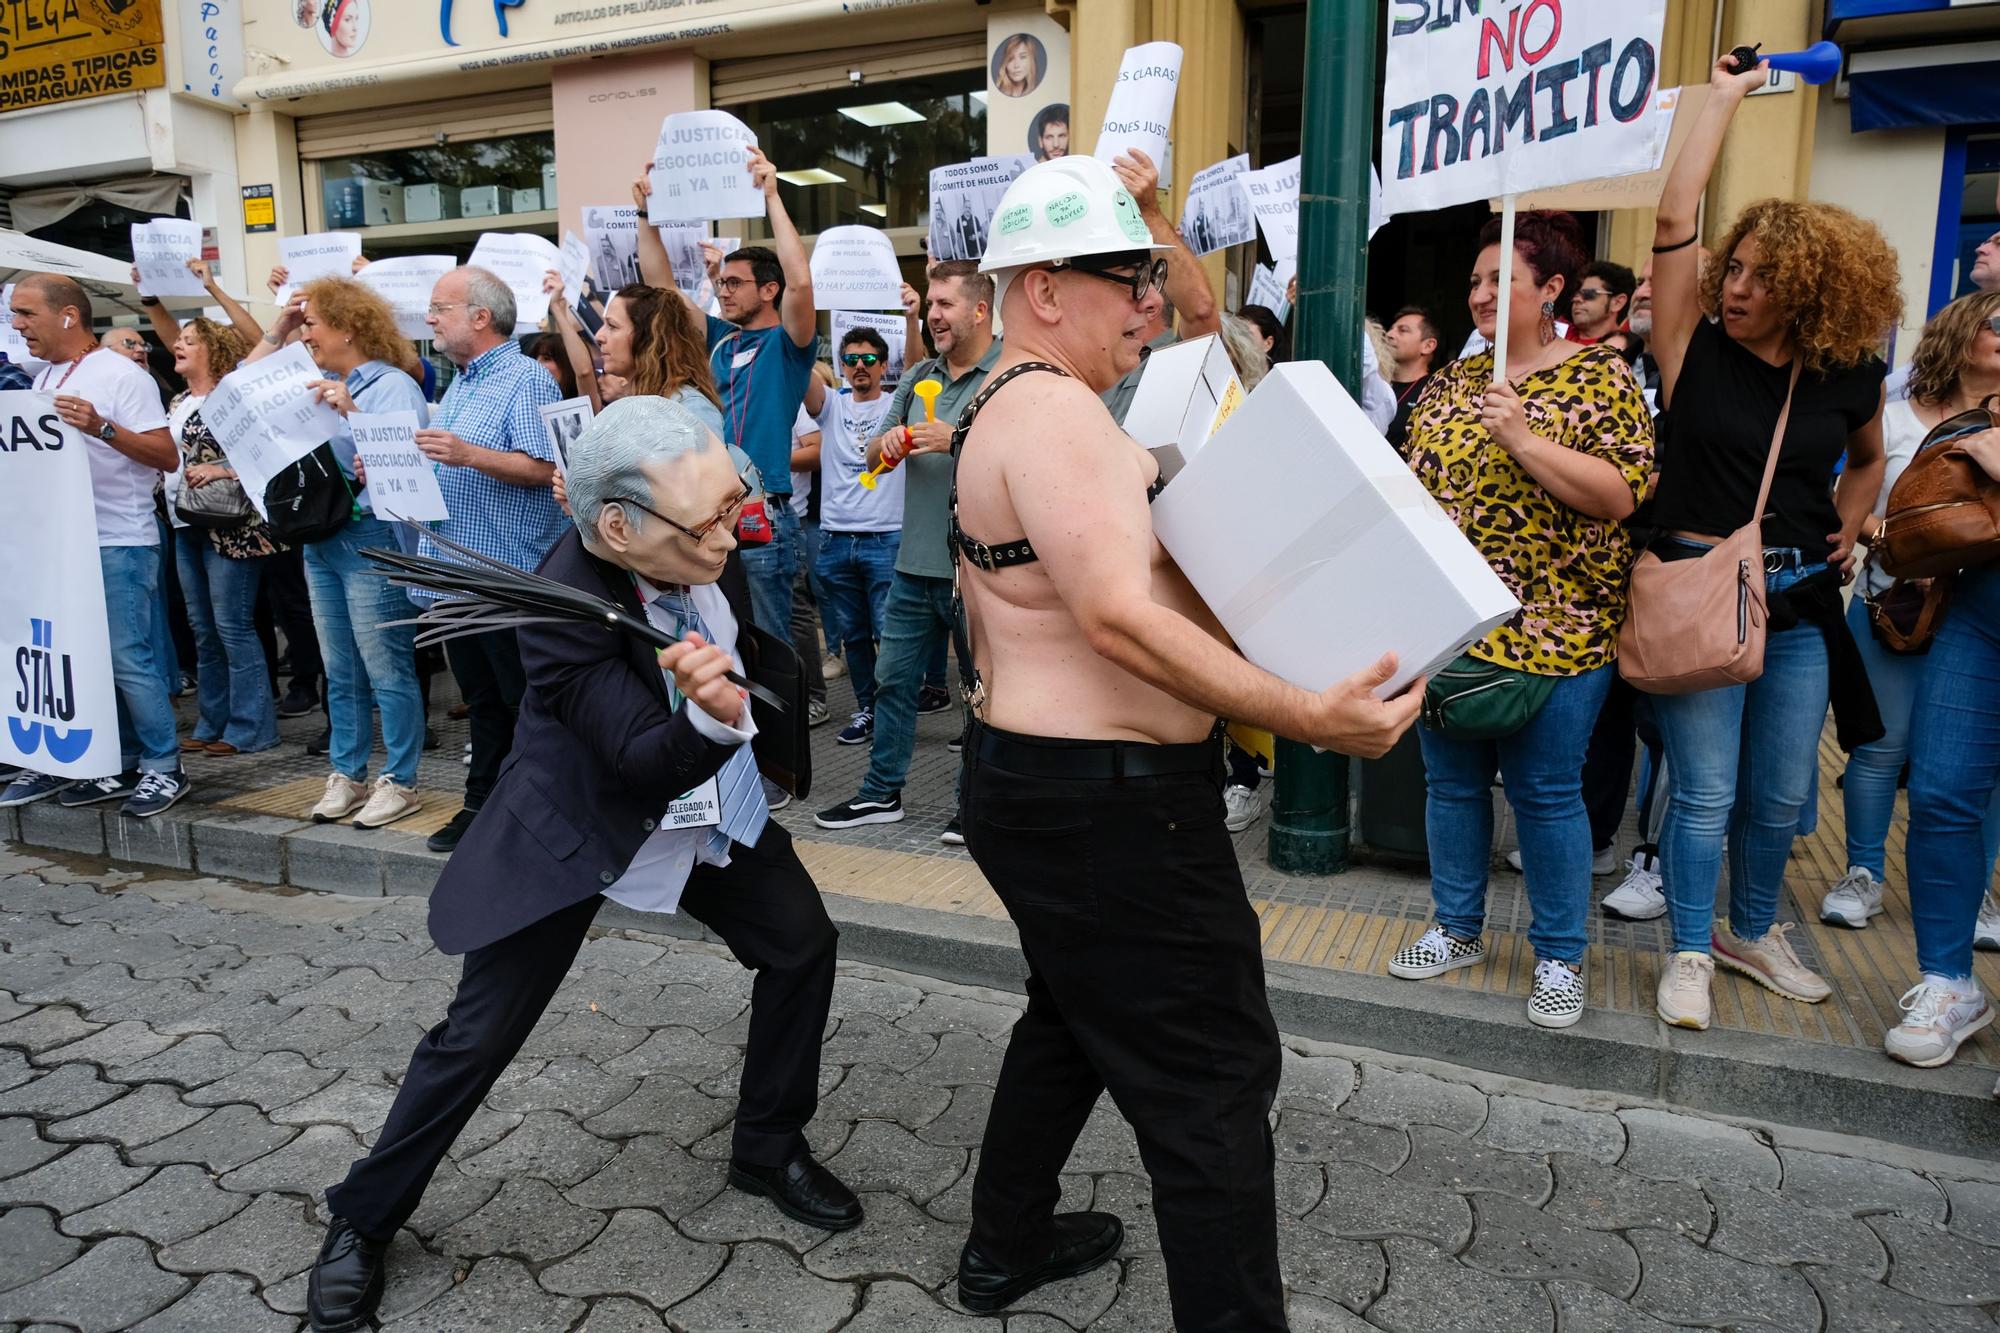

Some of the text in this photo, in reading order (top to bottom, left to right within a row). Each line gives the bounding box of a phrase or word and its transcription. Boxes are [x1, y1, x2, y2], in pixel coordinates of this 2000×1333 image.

[554, 7, 606, 25] ARTICULOS
[608, 4, 622, 18] DE
[1477, 0, 1563, 80] NO
[458, 60, 481, 72] WIGS
[483, 58, 499, 69] AND
[554, 46, 587, 58] BEAUTY
[590, 42, 609, 54] AND
[611, 31, 676, 50] HAIRDRESSING
[0, 47, 158, 91] MIDAS TIPICAS
[0, 70, 133, 109] PARAGUAYAS
[1388, 37, 1656, 180] TRAMITO
[671, 126, 751, 145] JUSTICIA
[944, 163, 999, 178] TODOS SOMOS
[688, 178, 710, 192] YA
[966, 178, 977, 188] DE
[978, 174, 1011, 187] HUELGA
[1249, 184, 1270, 197] EN
[825, 281, 846, 291] HAY
[846, 281, 889, 292] JUSTICIA
[852, 316, 897, 326] TODOS SOMOS
[227, 360, 309, 411] JUSTICIA
[259, 424, 287, 442] YA
[353, 426, 415, 443] EN JUSTICIA
[387, 478, 403, 493] YA
[15, 645, 77, 723] STAJ
[673, 812, 708, 825] SINDICAL
